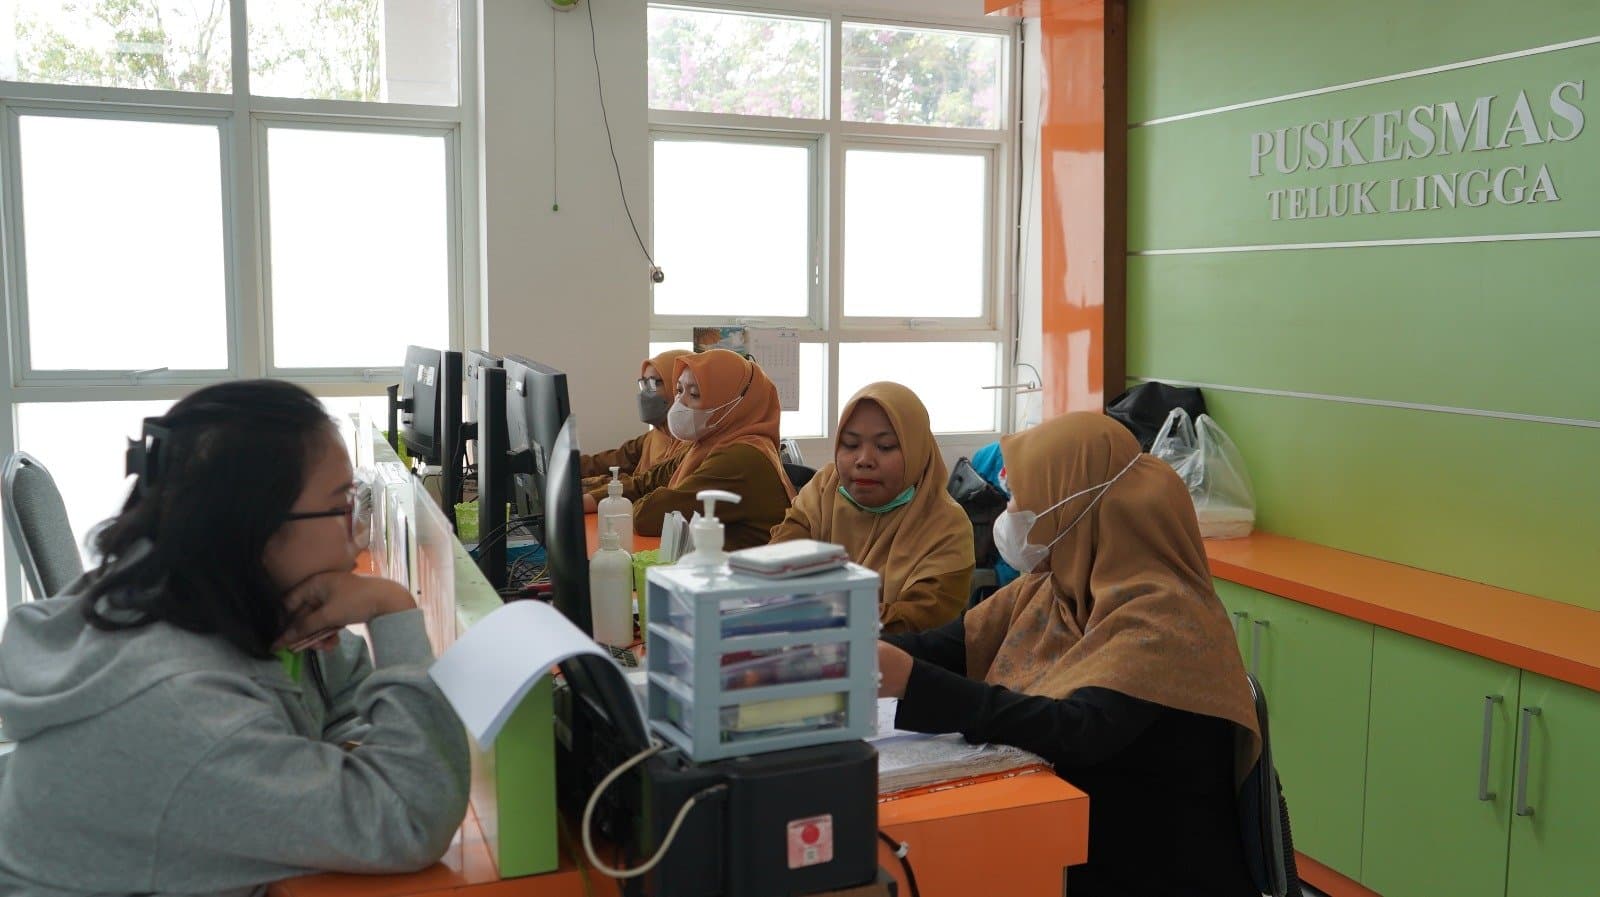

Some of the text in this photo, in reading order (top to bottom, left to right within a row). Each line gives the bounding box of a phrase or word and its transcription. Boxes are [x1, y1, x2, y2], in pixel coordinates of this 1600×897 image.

[1249, 80, 1585, 177] PUSKESMAS
[1268, 164, 1560, 221] TELUK LINGGA
